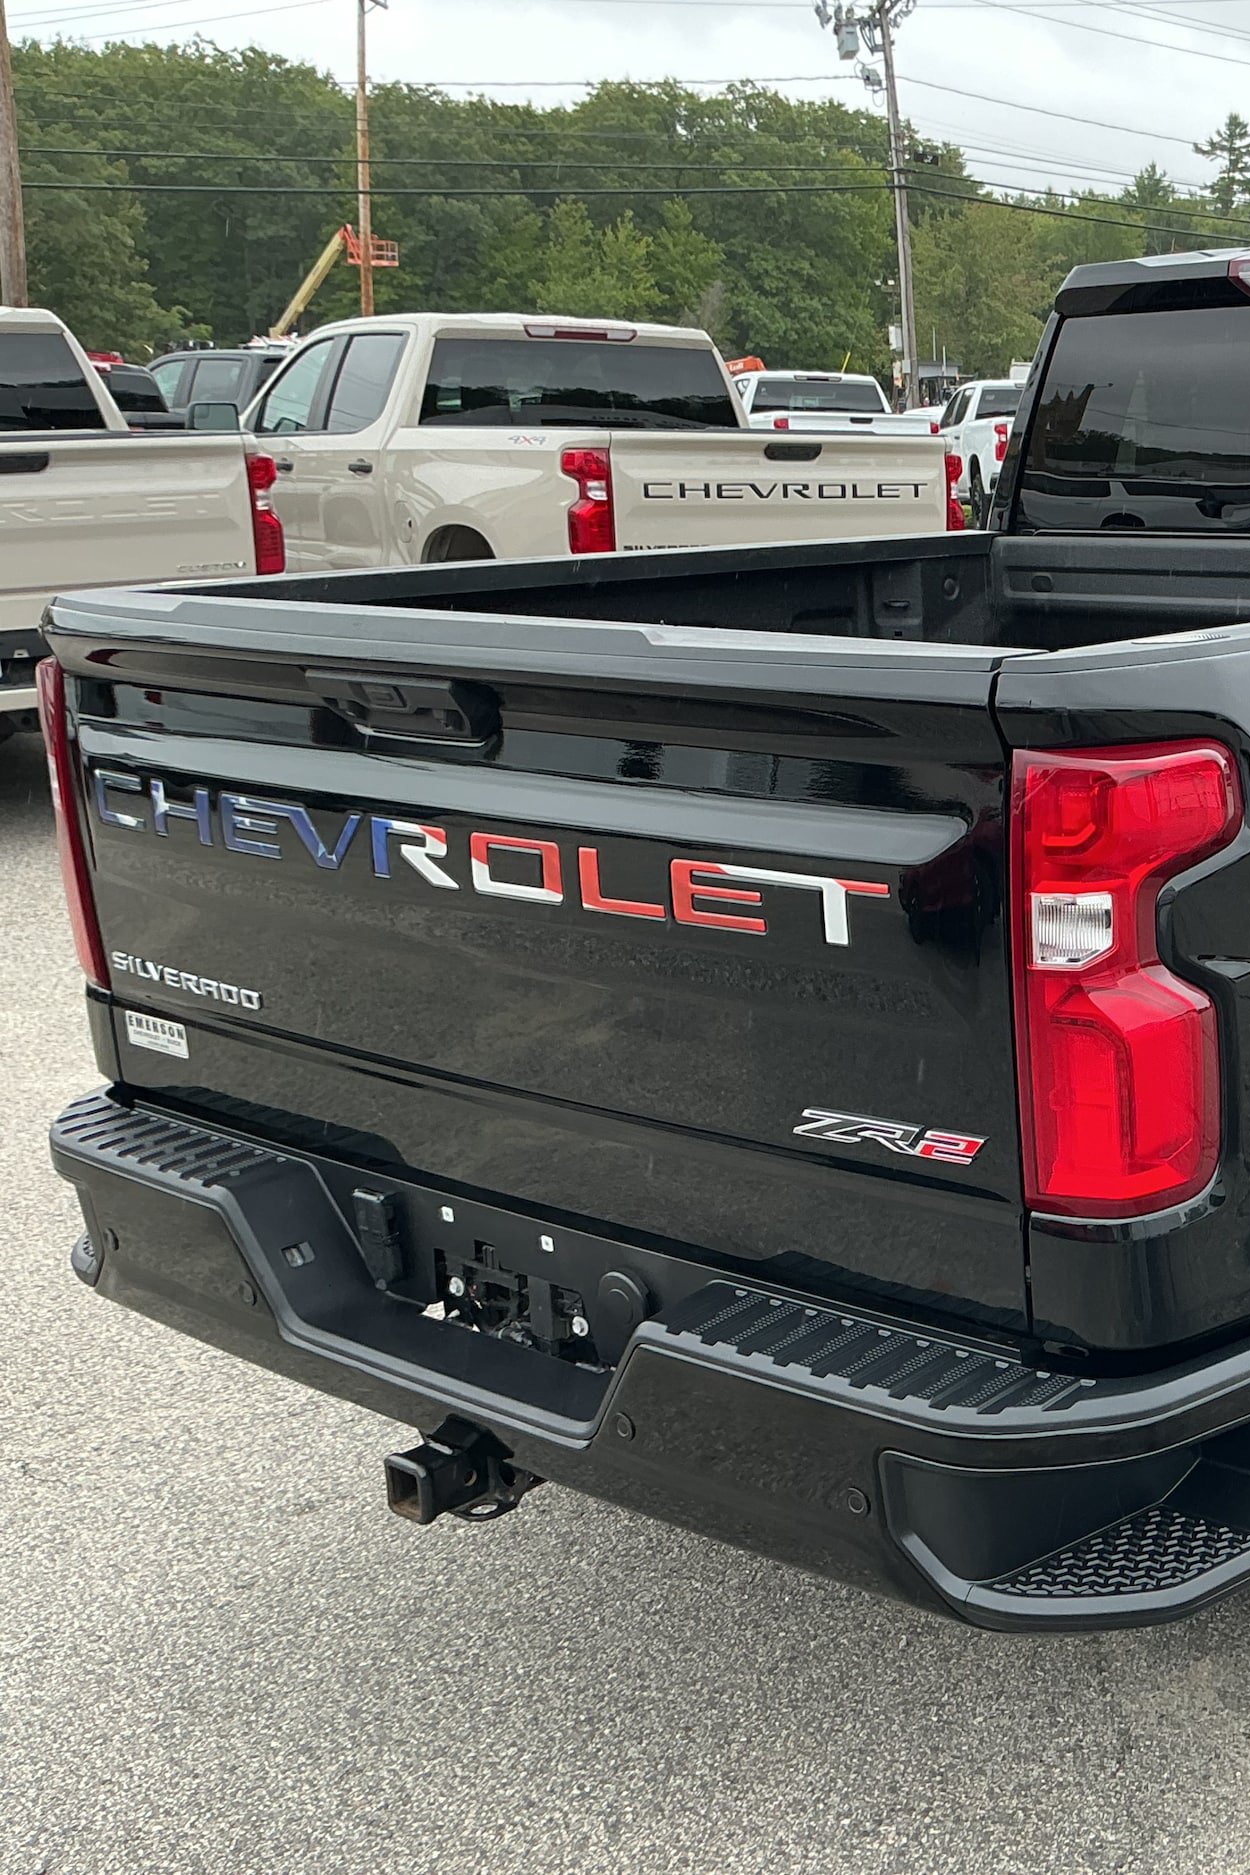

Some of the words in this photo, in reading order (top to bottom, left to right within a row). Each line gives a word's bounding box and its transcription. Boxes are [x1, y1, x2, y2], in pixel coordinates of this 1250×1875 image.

[642, 482, 929, 500] CHEVROLET
[176, 561, 248, 574] CUSTOM
[95, 768, 892, 947] CHEVROLET
[111, 949, 264, 1011] SILVERADO
[128, 1014, 185, 1041] EMERSON
[792, 1105, 990, 1166] ZR2
